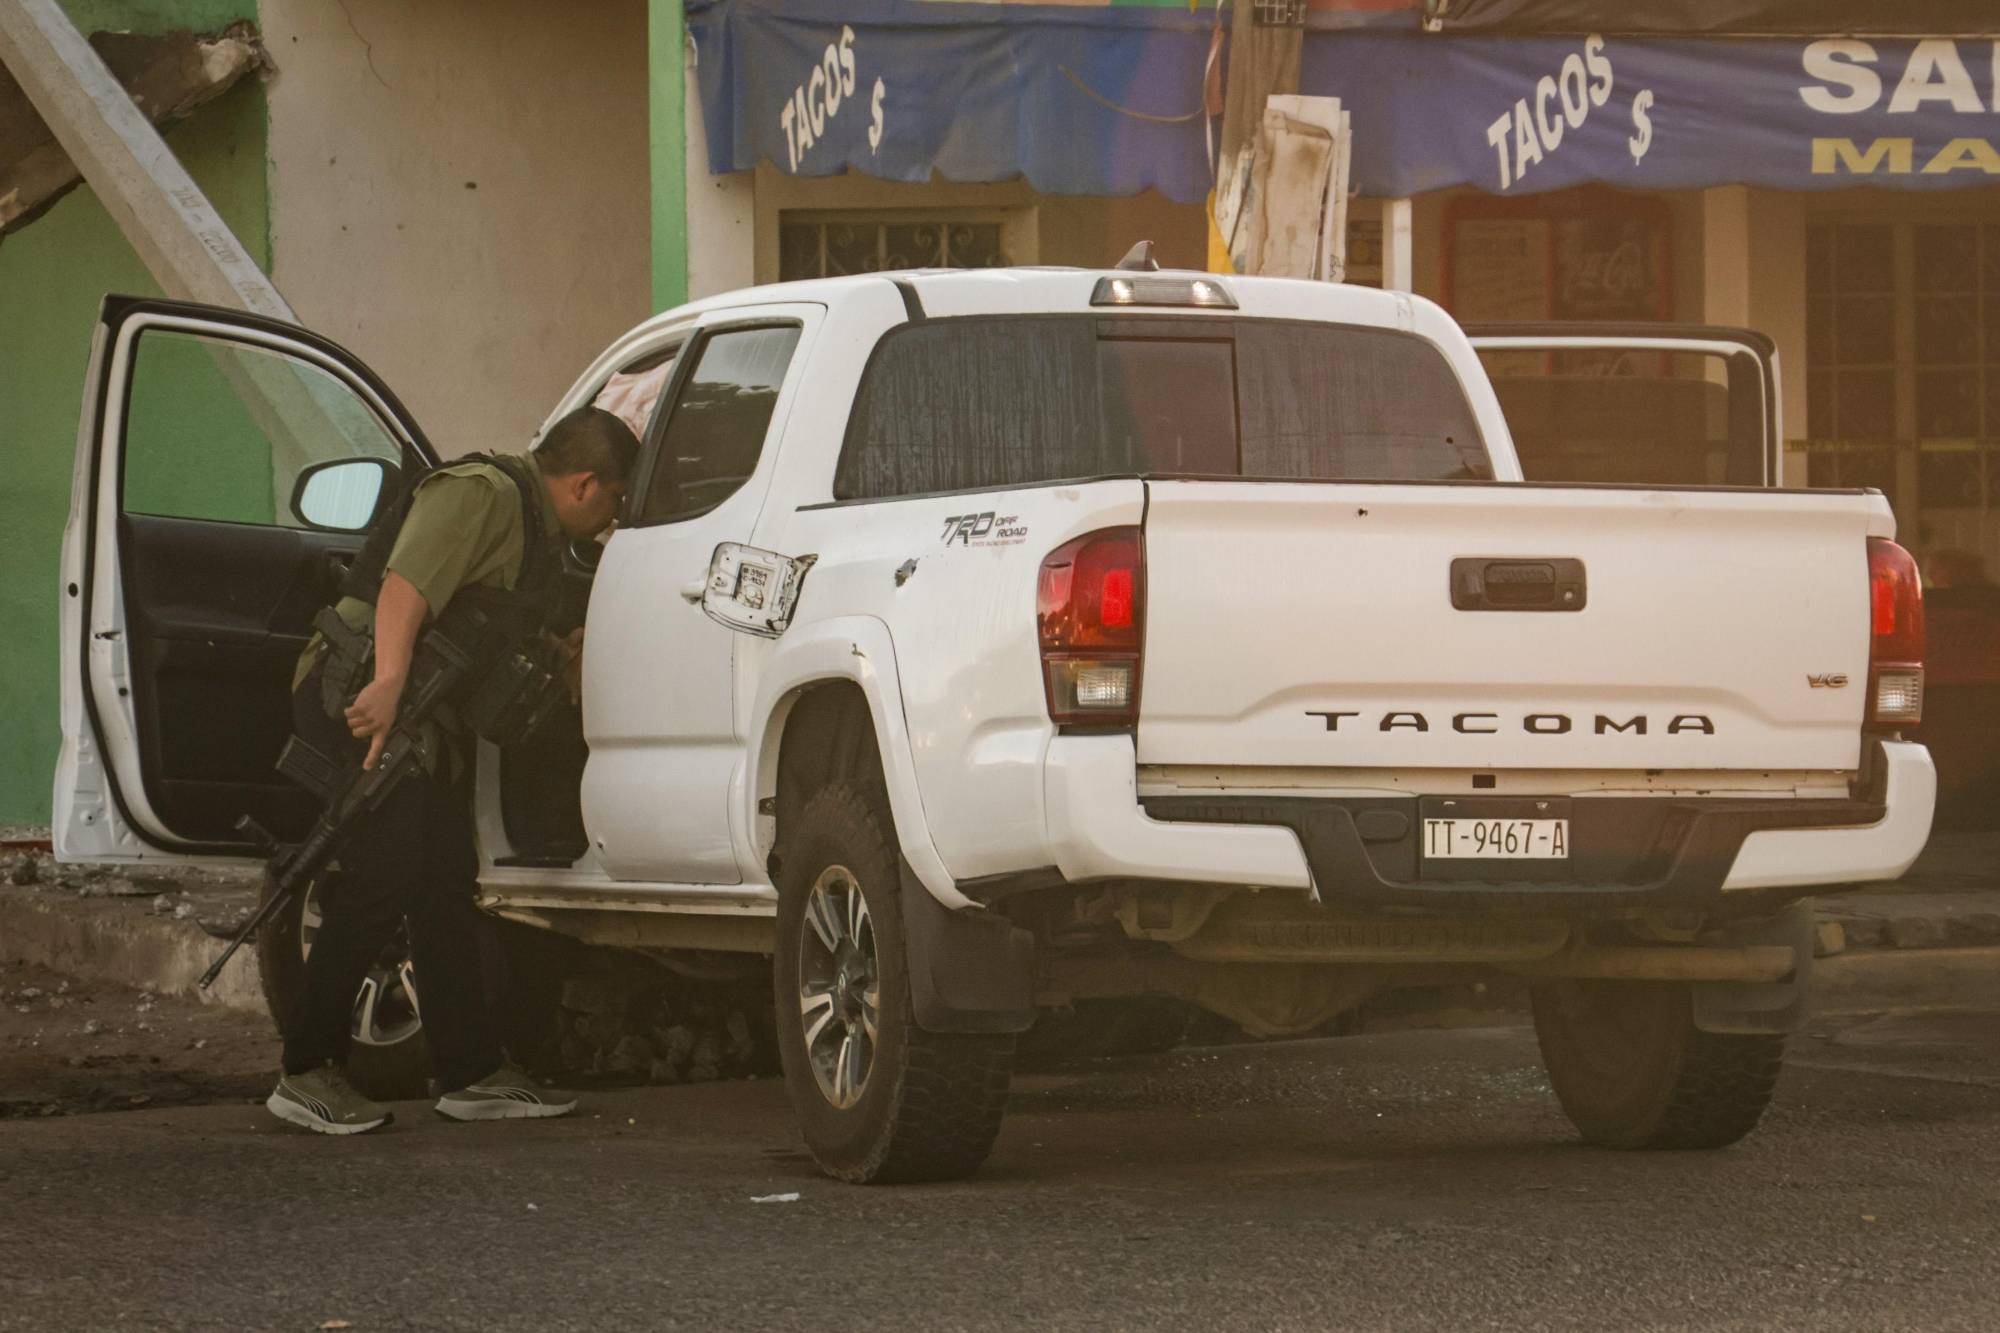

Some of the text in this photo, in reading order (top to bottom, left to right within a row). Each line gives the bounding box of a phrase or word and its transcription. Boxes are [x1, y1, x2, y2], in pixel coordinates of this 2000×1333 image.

[1798, 38, 2000, 115] SA
[781, 24, 856, 174] TACOS
[1486, 32, 1654, 190] TACOS $
[940, 511, 996, 548] TRD
[995, 515, 1019, 527] OFF
[997, 526, 1028, 538] ROAD
[1305, 711, 1715, 735] TACOMA
[1427, 820, 1565, 856] TT-9467-A
